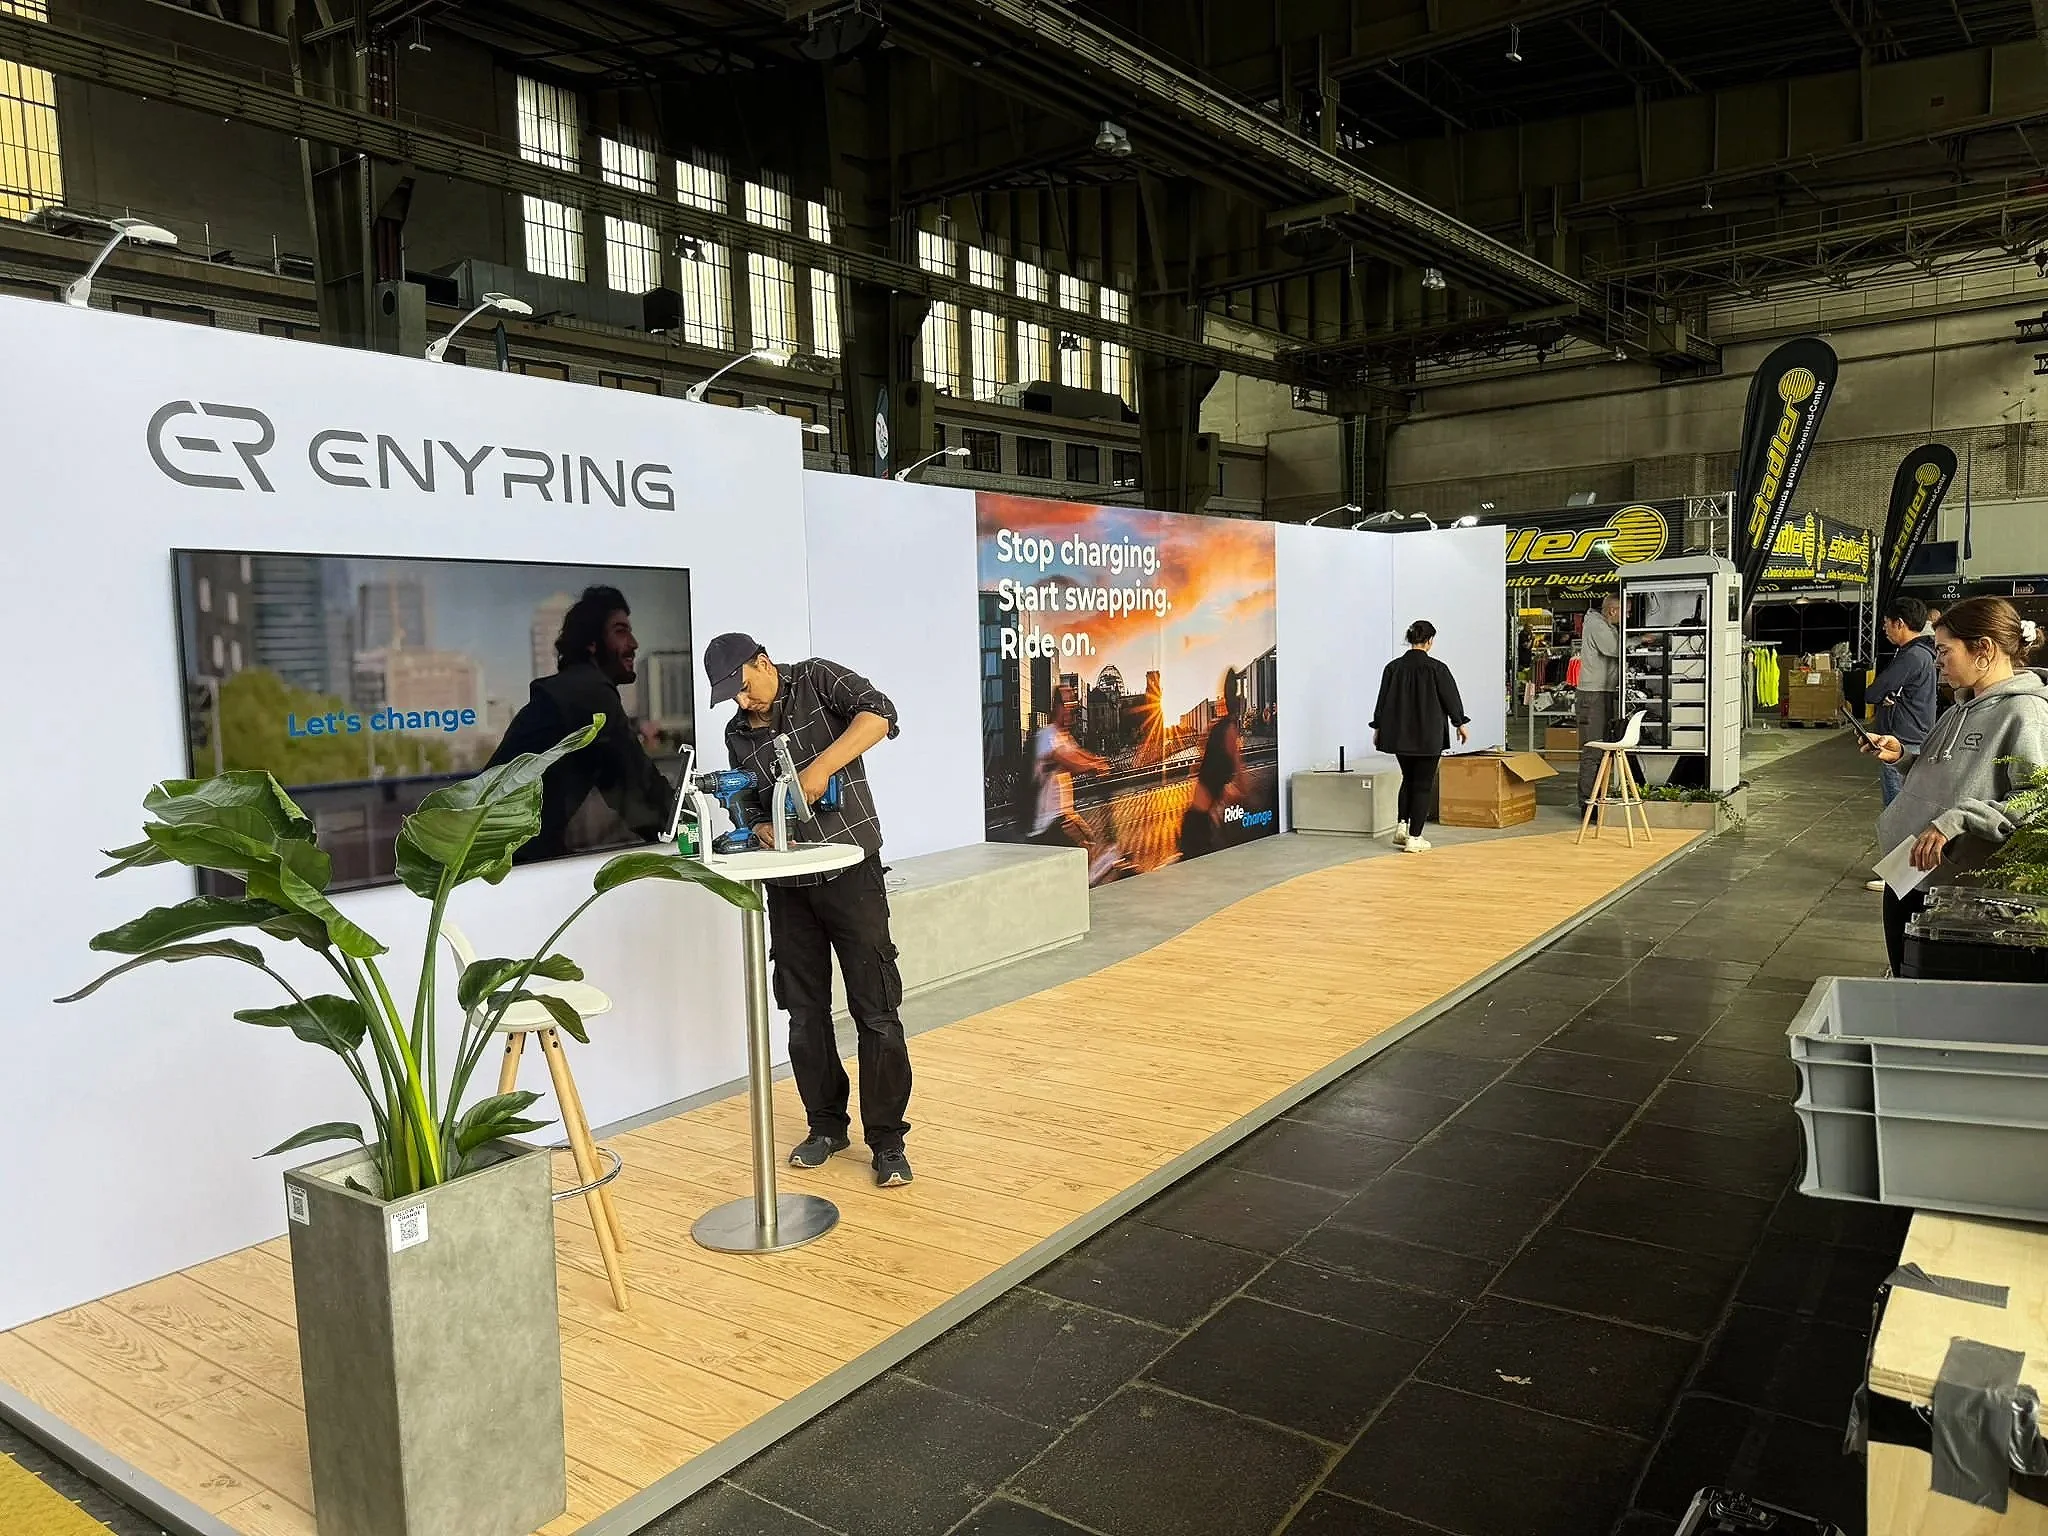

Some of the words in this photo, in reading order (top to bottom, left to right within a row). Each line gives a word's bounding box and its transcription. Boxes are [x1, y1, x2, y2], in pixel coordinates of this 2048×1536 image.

[1797, 380, 1827, 451] Zweirad-Center
[146, 400, 276, 493] ER
[308, 429, 676, 512] ENYRING
[1749, 394, 1800, 549] stadler
[1889, 480, 1928, 579] stadler
[996, 529, 1055, 572] Stop
[1060, 534, 1161, 575] charging.
[999, 579, 1060, 612] Start
[1065, 580, 1172, 618] swapping.
[1001, 624, 1055, 660] Ride
[1061, 631, 1097, 657] on.
[287, 710, 362, 737] Let's
[370, 706, 477, 733] change
[1224, 804, 1245, 823] Ride
[1242, 809, 1272, 828] change
[392, 1208, 414, 1219] FOLLOW
